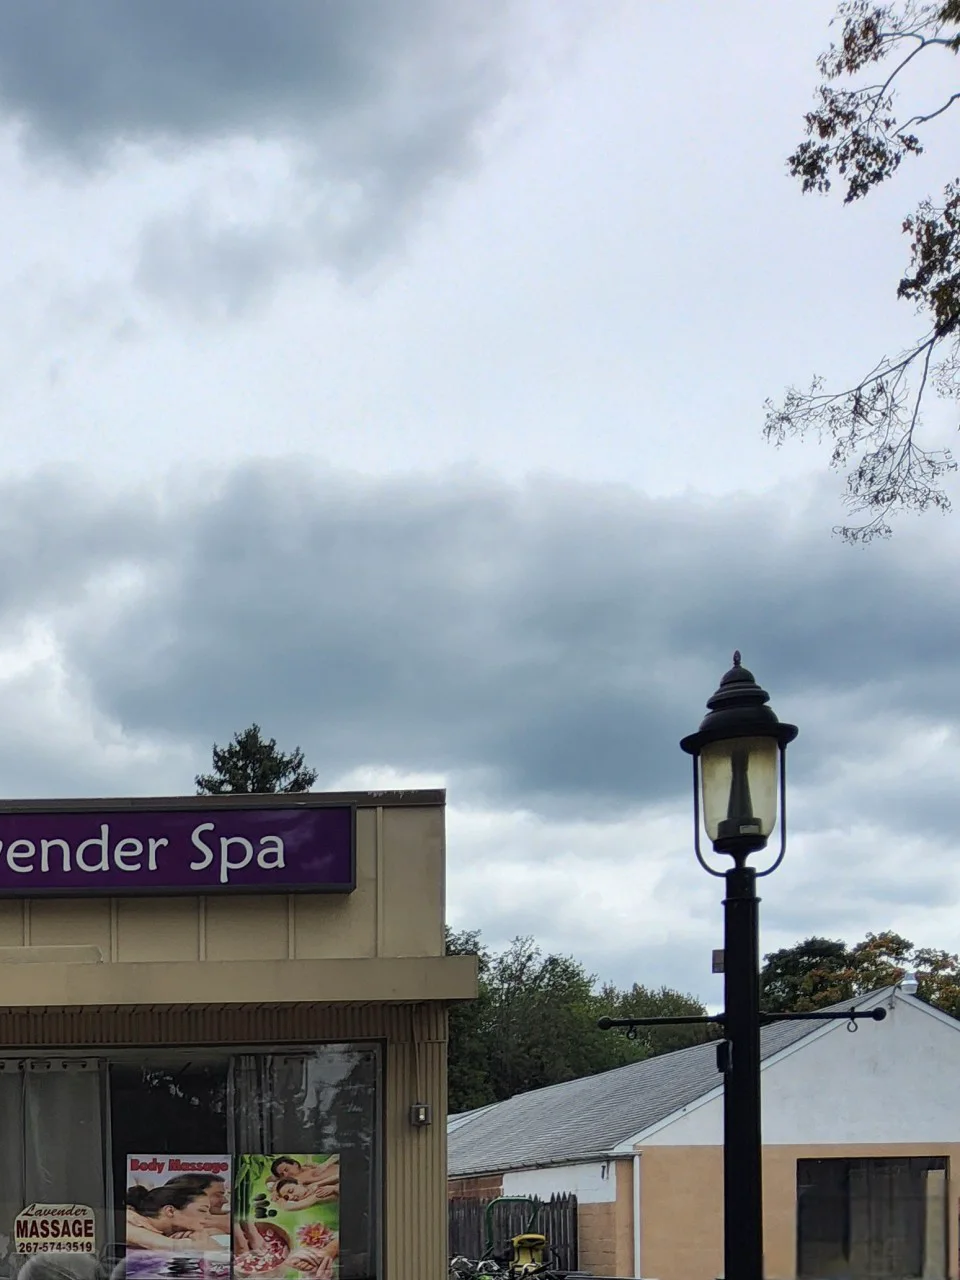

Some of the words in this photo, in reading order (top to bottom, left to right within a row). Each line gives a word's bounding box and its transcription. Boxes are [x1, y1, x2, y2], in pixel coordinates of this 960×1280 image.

[189, 822, 286, 884] Spa
[130, 1158, 165, 1174] Body
[168, 1159, 229, 1174] Massage
[22, 1204, 88, 1217] Lavender
[16, 1219, 94, 1238] MASSAGE
[19, 1241, 92, 1253] 267-574-3519
